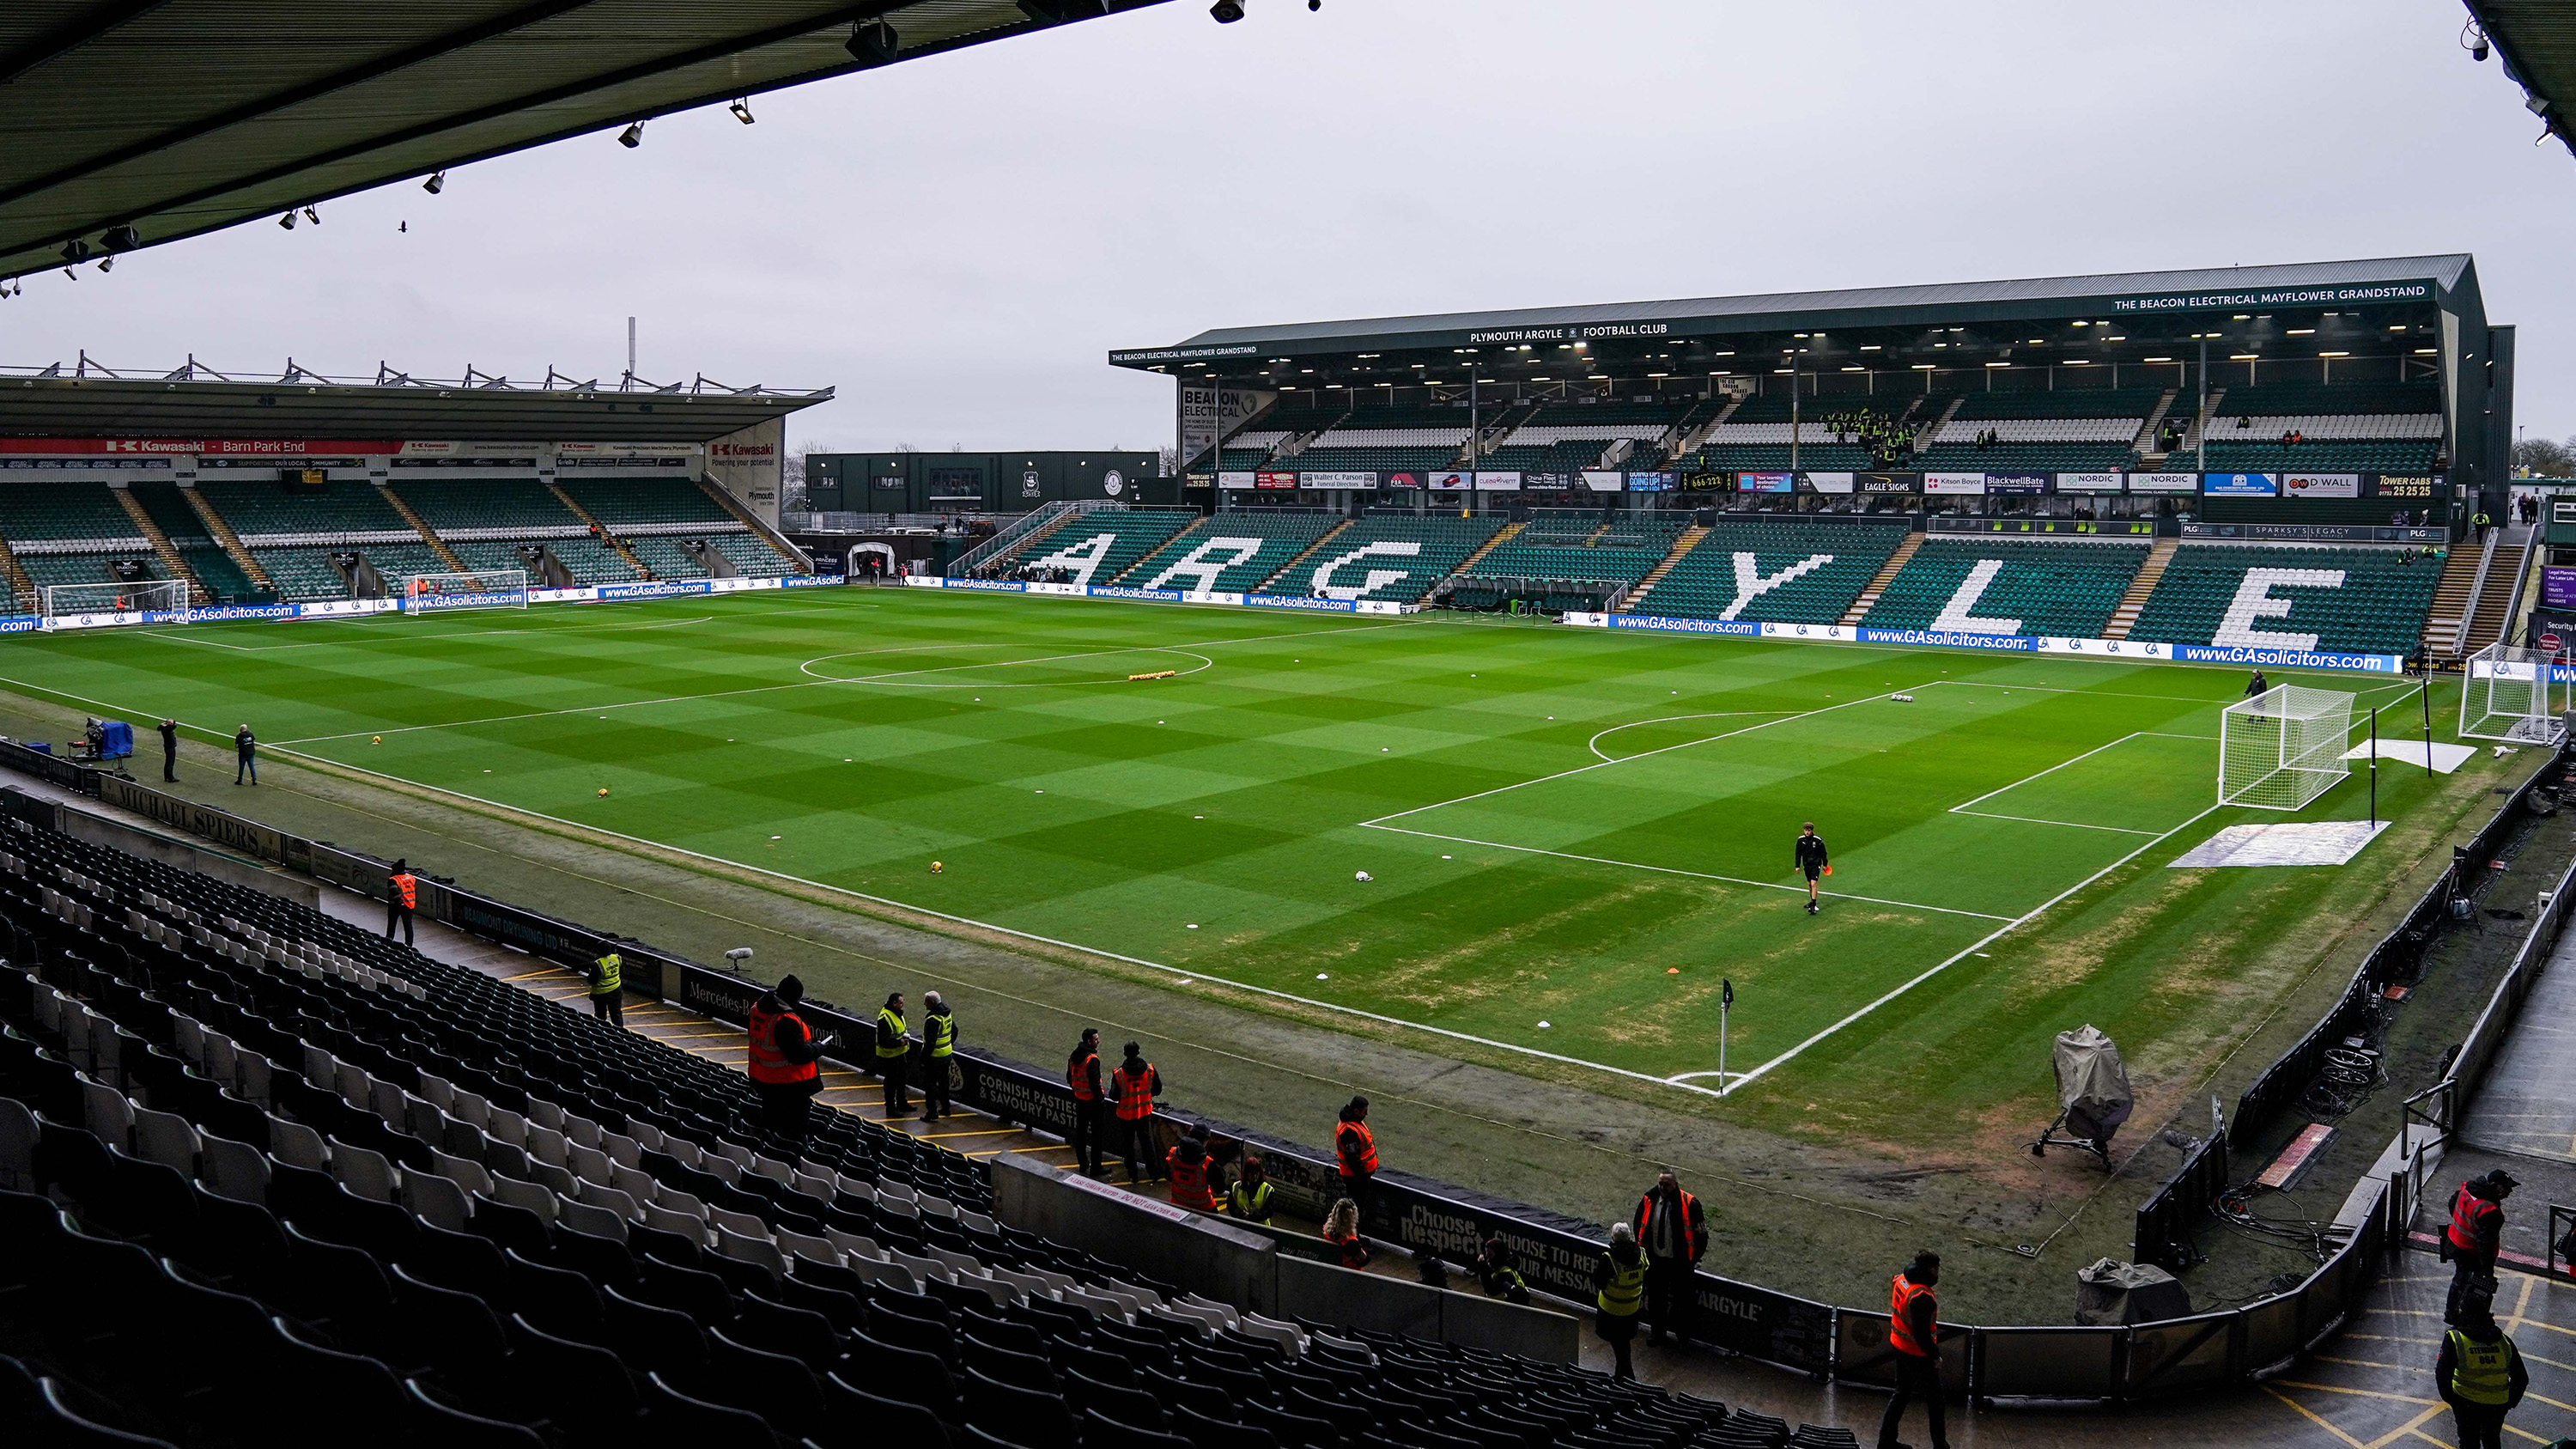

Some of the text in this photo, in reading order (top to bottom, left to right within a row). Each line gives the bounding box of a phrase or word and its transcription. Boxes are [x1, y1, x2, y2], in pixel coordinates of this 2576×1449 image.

[2115, 286, 2425, 310] THE BEACON ELECTRICAL MAYFLOWER GRANDSTAND
[1471, 329, 1563, 342] PLYMOUTH ARGYLE
[1583, 324, 1668, 337] FOOTBALL CLUB
[1147, 350, 1180, 359] ELECTRICAL
[1181, 349, 1215, 357] MAYFLOWER
[1216, 346, 1256, 355] GRANDSTAND
[1185, 405, 1239, 417] ELECTCAL
[142, 441, 305, 452] Kawasaki Barn Park End
[732, 444, 774, 455] Kawasaki
[750, 458, 775, 466] potential
[1692, 476, 1721, 487] 666-222
[1865, 483, 1909, 491] EAGLE SIGNS
[1987, 476, 2044, 484] BlackwellBate
[2379, 475, 2409, 485] TOWER
[2409, 477, 2431, 485] CABS
[749, 492, 775, 501] Plymouth
[2393, 486, 2405, 496] 25
[2406, 486, 2417, 496] 25
[2419, 486, 2431, 496] 25
[605, 581, 706, 598] www.GAsolicitors.com
[947, 579, 1022, 592] www.GAsolicitors.com
[1092, 586, 1178, 601] www.GAsolicitors.com
[406, 592, 522, 609] www.GAsolicitors.com
[1249, 595, 1350, 612] www.GAsolicitors.com
[1718, 551, 1833, 621] Y
[1929, 559, 2023, 636] L
[2211, 567, 2346, 651] E
[154, 606, 293, 623] www.GAsolicitors.com
[1618, 616, 1753, 635] www.GAsolicitors.com
[2548, 622, 2573, 630] Security
[1868, 629, 2028, 650] www.GAsolicitors.com
[2186, 647, 2382, 672] www.GAsolicitors.com
[118, 784, 259, 852] MICHAEL SPIERS
[463, 904, 558, 951] BEAUMONT DRYLINING LTD
[689, 981, 750, 1016] Mercedes-B
[978, 1074, 1031, 1100] CORNISH
[1033, 1090, 1077, 1115] PASTIES
[979, 1087, 1042, 1118] & SAVOURY
[1121, 1193, 1132, 1202] DO
[1132, 1196, 1145, 1207] NOT
[1144, 1202, 1158, 1210] LEAN
[1157, 1206, 1170, 1215] OVER
[1170, 1211, 1183, 1220] WALL
[1411, 1203, 1476, 1237] Choose
[1400, 1216, 1484, 1255] Respect
[1494, 1229, 1571, 1264] CHOOSE TO
[1544, 1264, 1599, 1296] MESSA
[2469, 1346, 2500, 1355] STEWARD
[2478, 1355, 2497, 1365] 064
